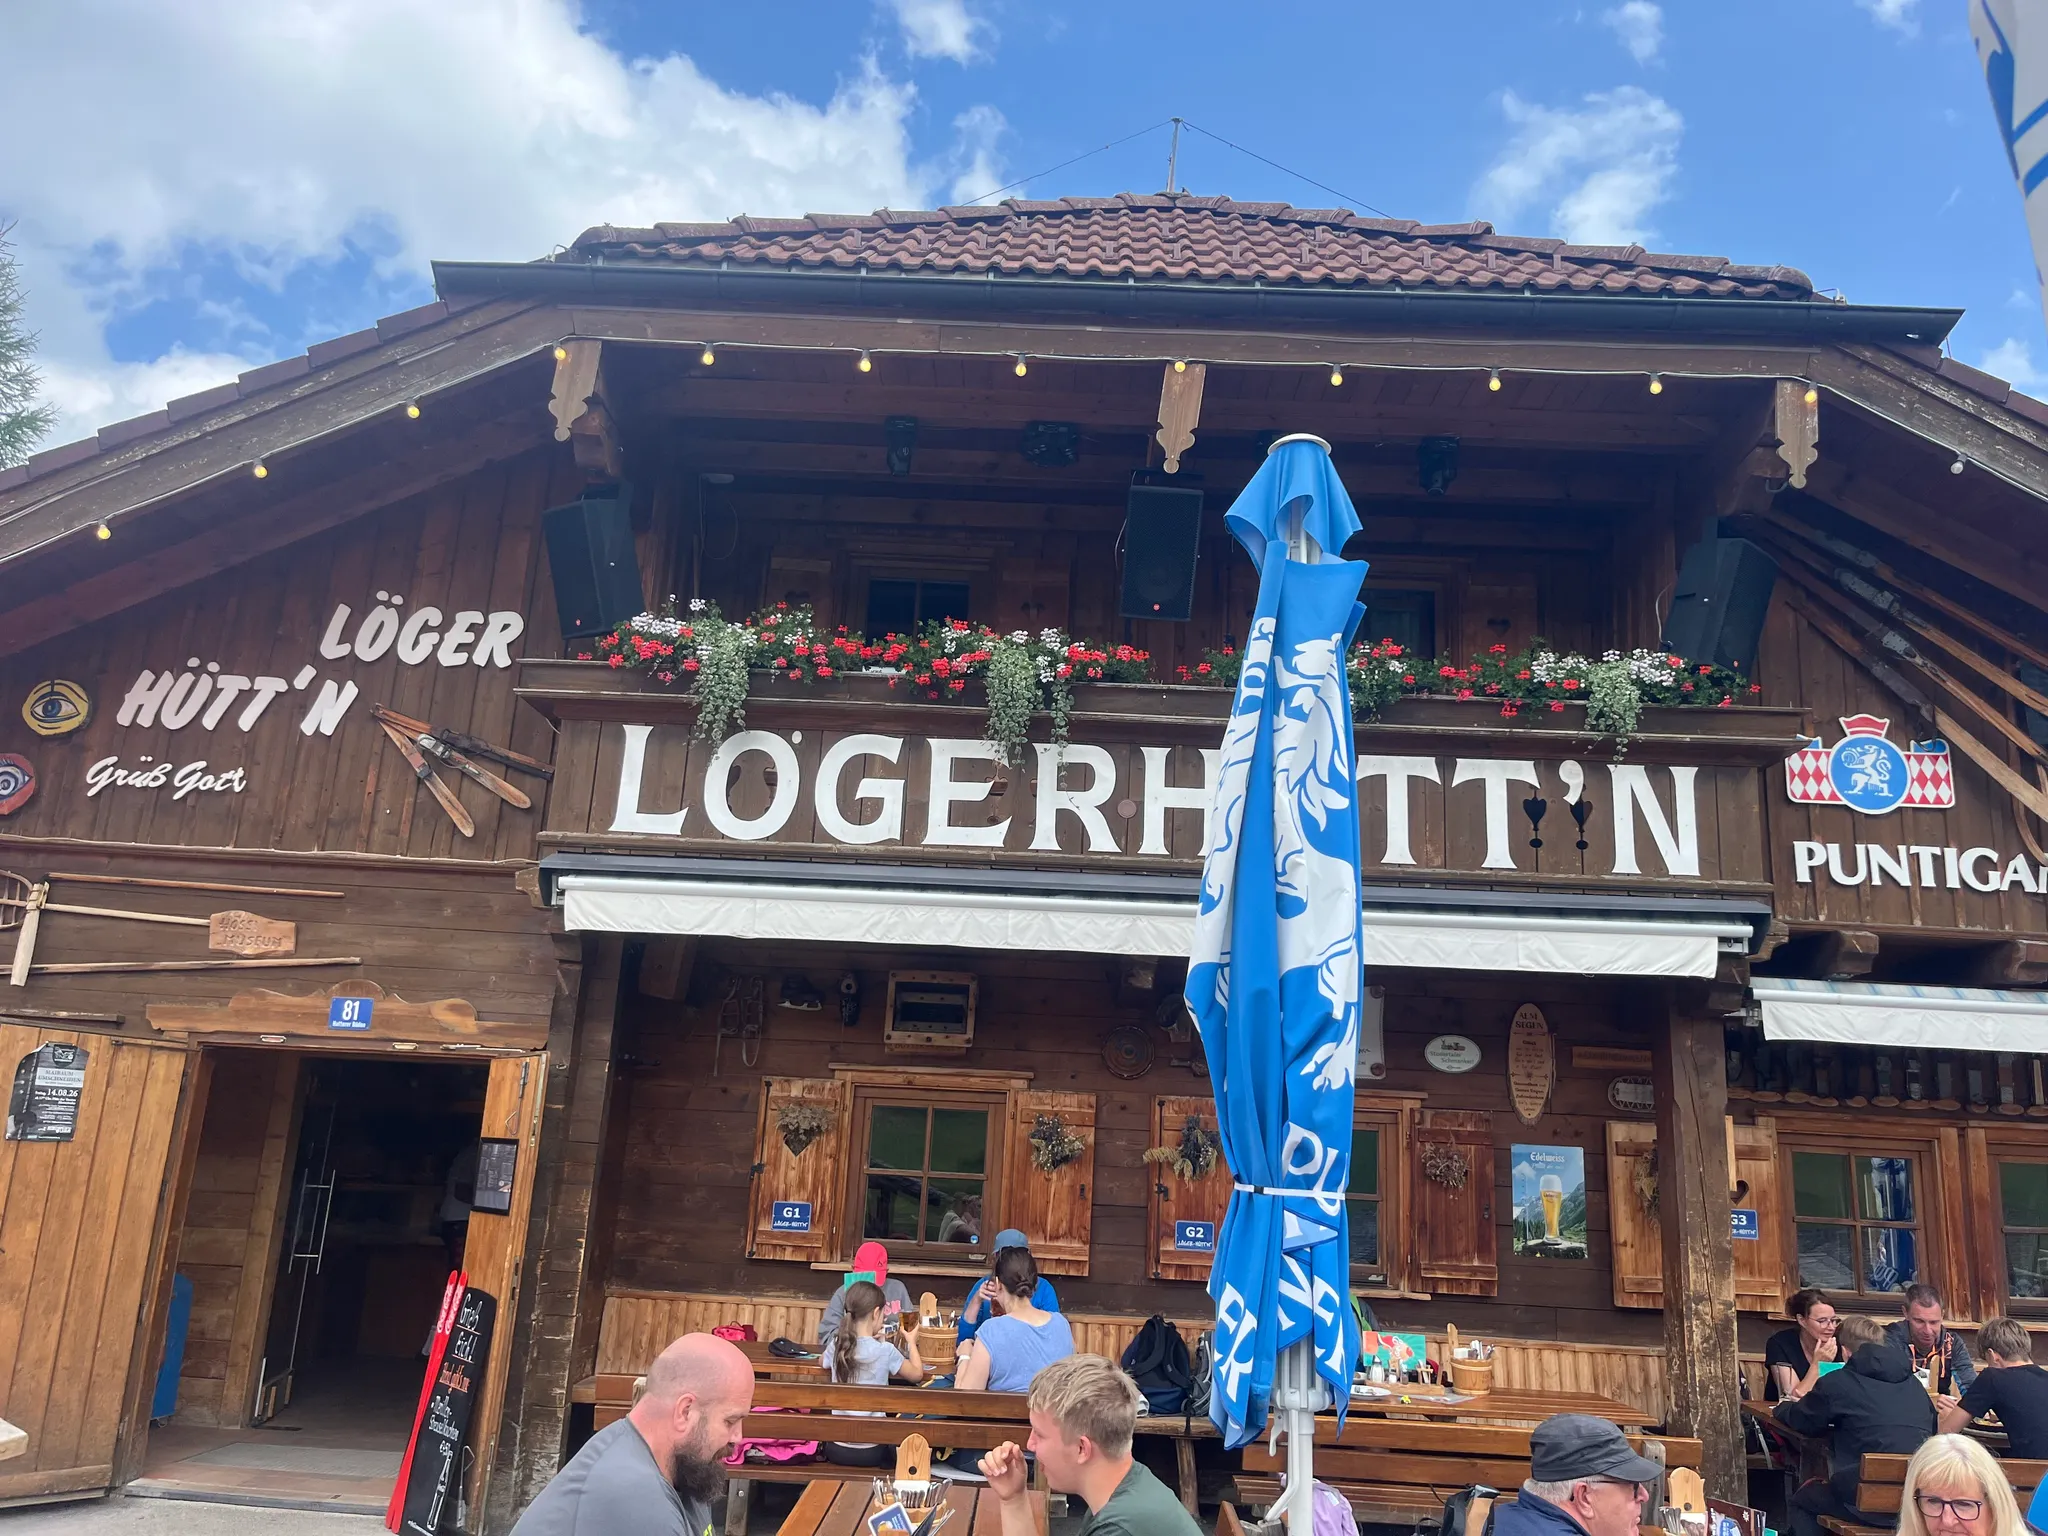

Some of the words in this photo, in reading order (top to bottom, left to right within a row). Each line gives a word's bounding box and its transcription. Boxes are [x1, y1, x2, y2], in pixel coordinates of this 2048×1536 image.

[320, 590, 524, 668] LÖGER
[116, 657, 359, 736] HÜTT'N
[86, 755, 173, 798] Grüß
[173, 760, 247, 800] Gott
[223, 933, 282, 949] MUSEUM
[342, 1000, 360, 1021] 81
[1515, 1021, 1544, 1029] SEGEN
[47, 1088, 79, 1098] 14.08.26
[1530, 1151, 1566, 1162] Edelweiss
[783, 1206, 801, 1218] G1
[1185, 1226, 1204, 1238] G2
